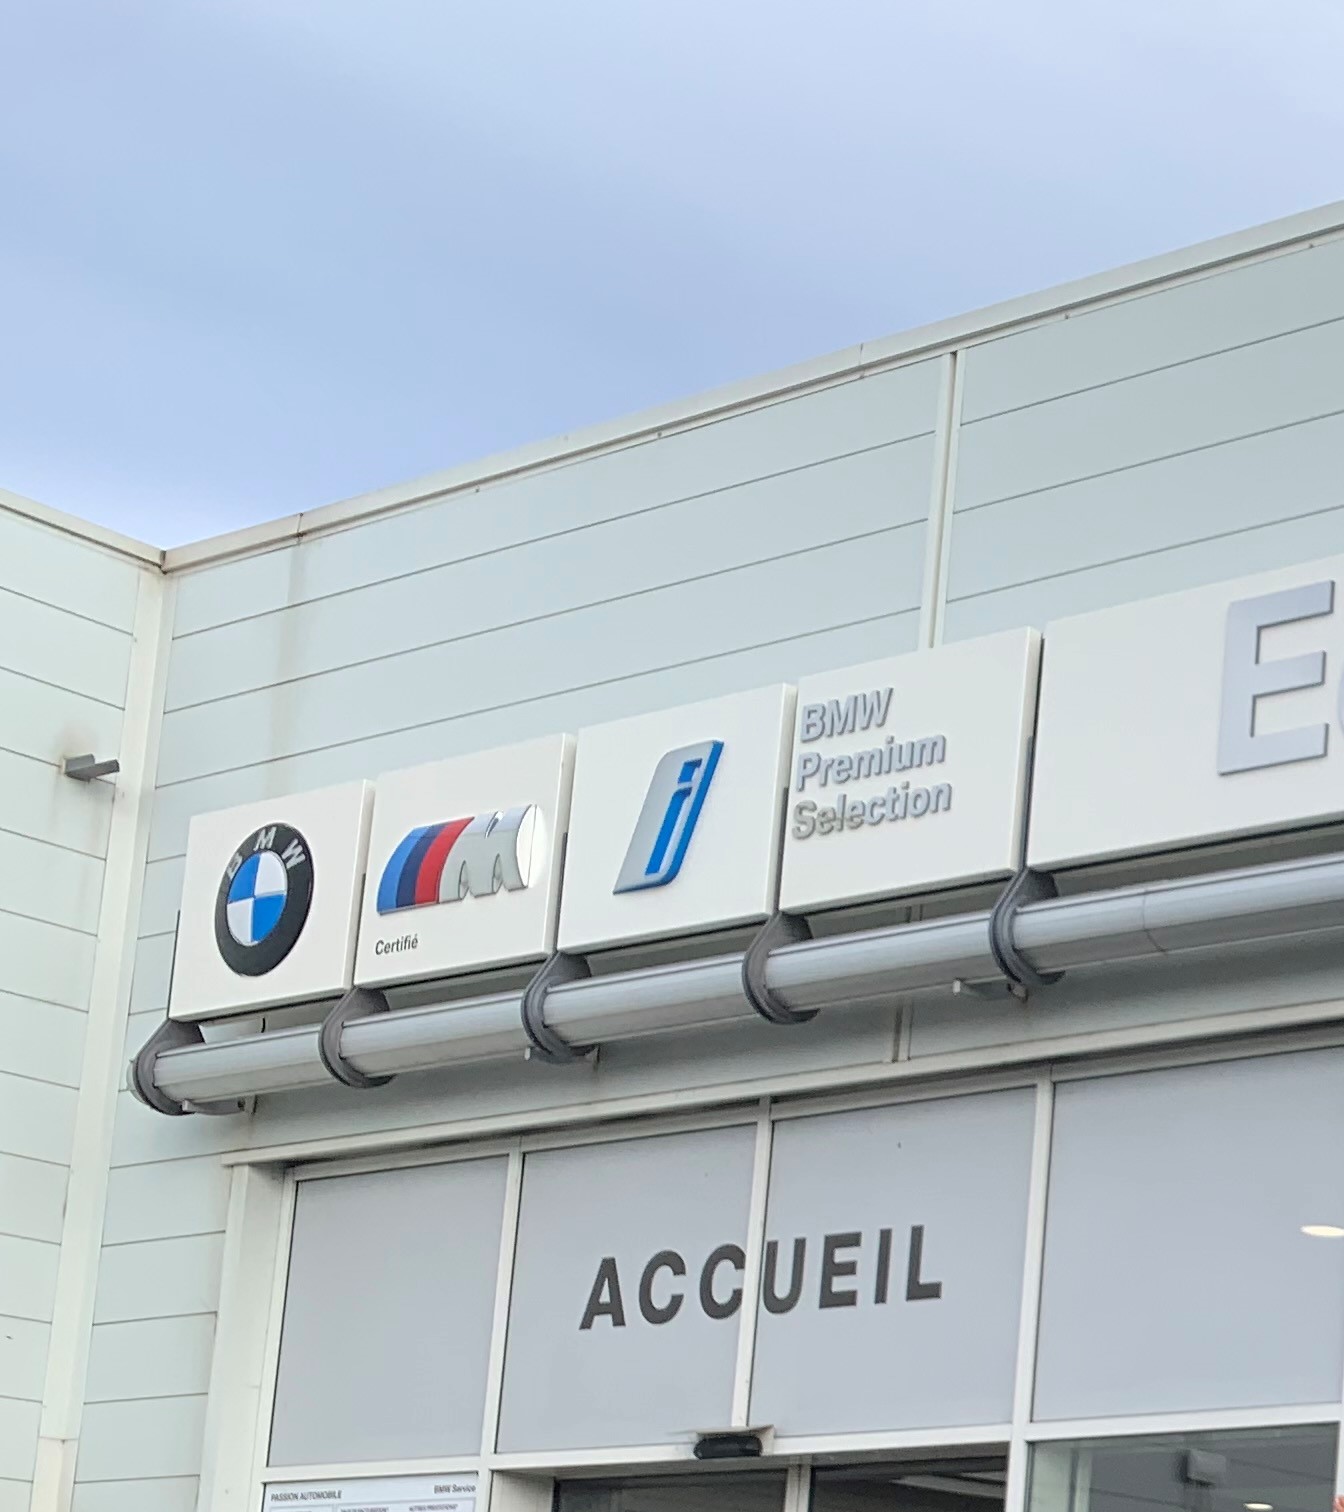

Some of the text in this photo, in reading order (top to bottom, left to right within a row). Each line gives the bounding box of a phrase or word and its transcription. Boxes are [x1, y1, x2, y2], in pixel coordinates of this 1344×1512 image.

[801, 687, 894, 743] BMW
[797, 735, 947, 792] Premium
[791, 781, 953, 840] Selection
[226, 826, 306, 880] BMW
[375, 933, 419, 956] Certifié
[578, 1224, 943, 1331] ACCUEIL
[270, 1491, 299, 1502] PASSION
